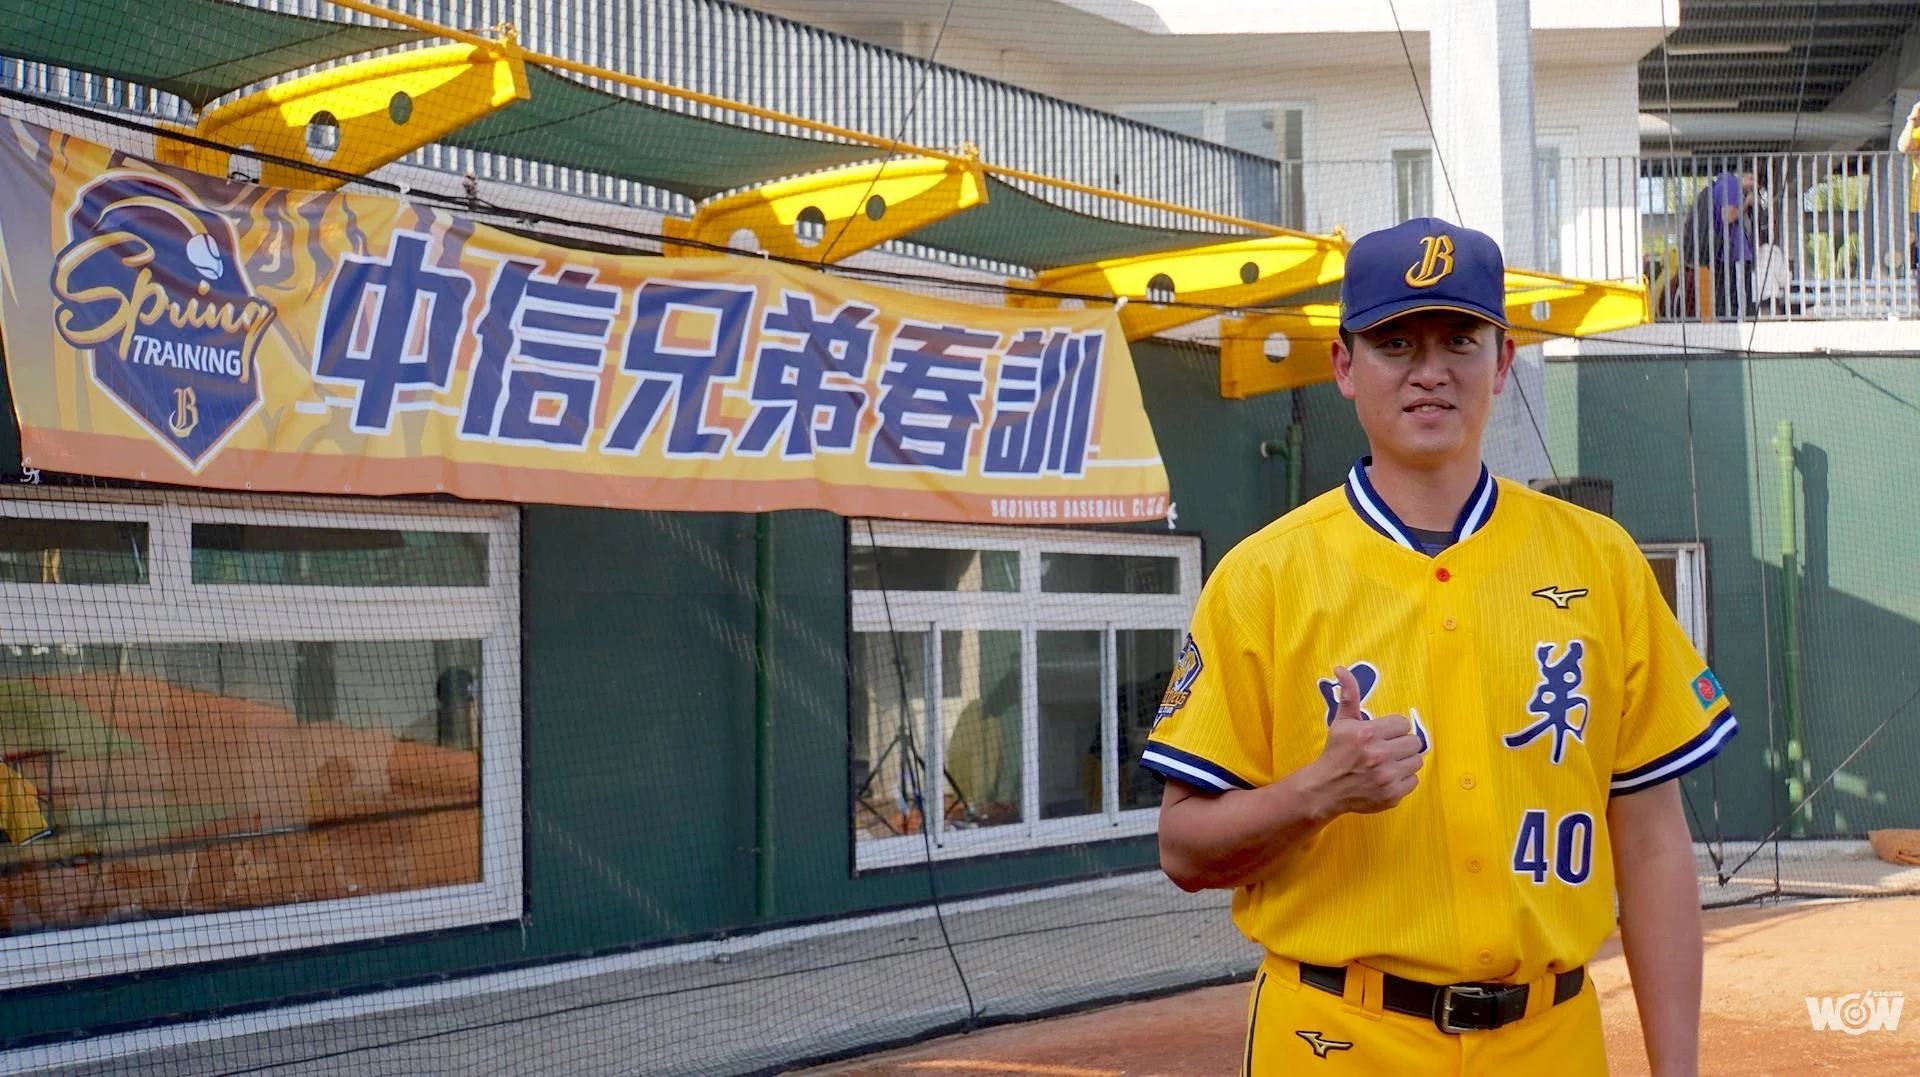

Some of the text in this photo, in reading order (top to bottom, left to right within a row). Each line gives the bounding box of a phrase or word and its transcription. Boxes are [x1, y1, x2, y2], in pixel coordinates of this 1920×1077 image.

[1405, 234, 1455, 288] B
[56, 231, 272, 384] Spring
[132, 335, 242, 376] TRAINING
[311, 228, 1104, 482] 中信兄弟春訓
[169, 386, 199, 438] B
[991, 499, 1057, 519] BROTHERS
[1063, 499, 1126, 519] BASEBALL
[1511, 808, 1593, 885] 40
